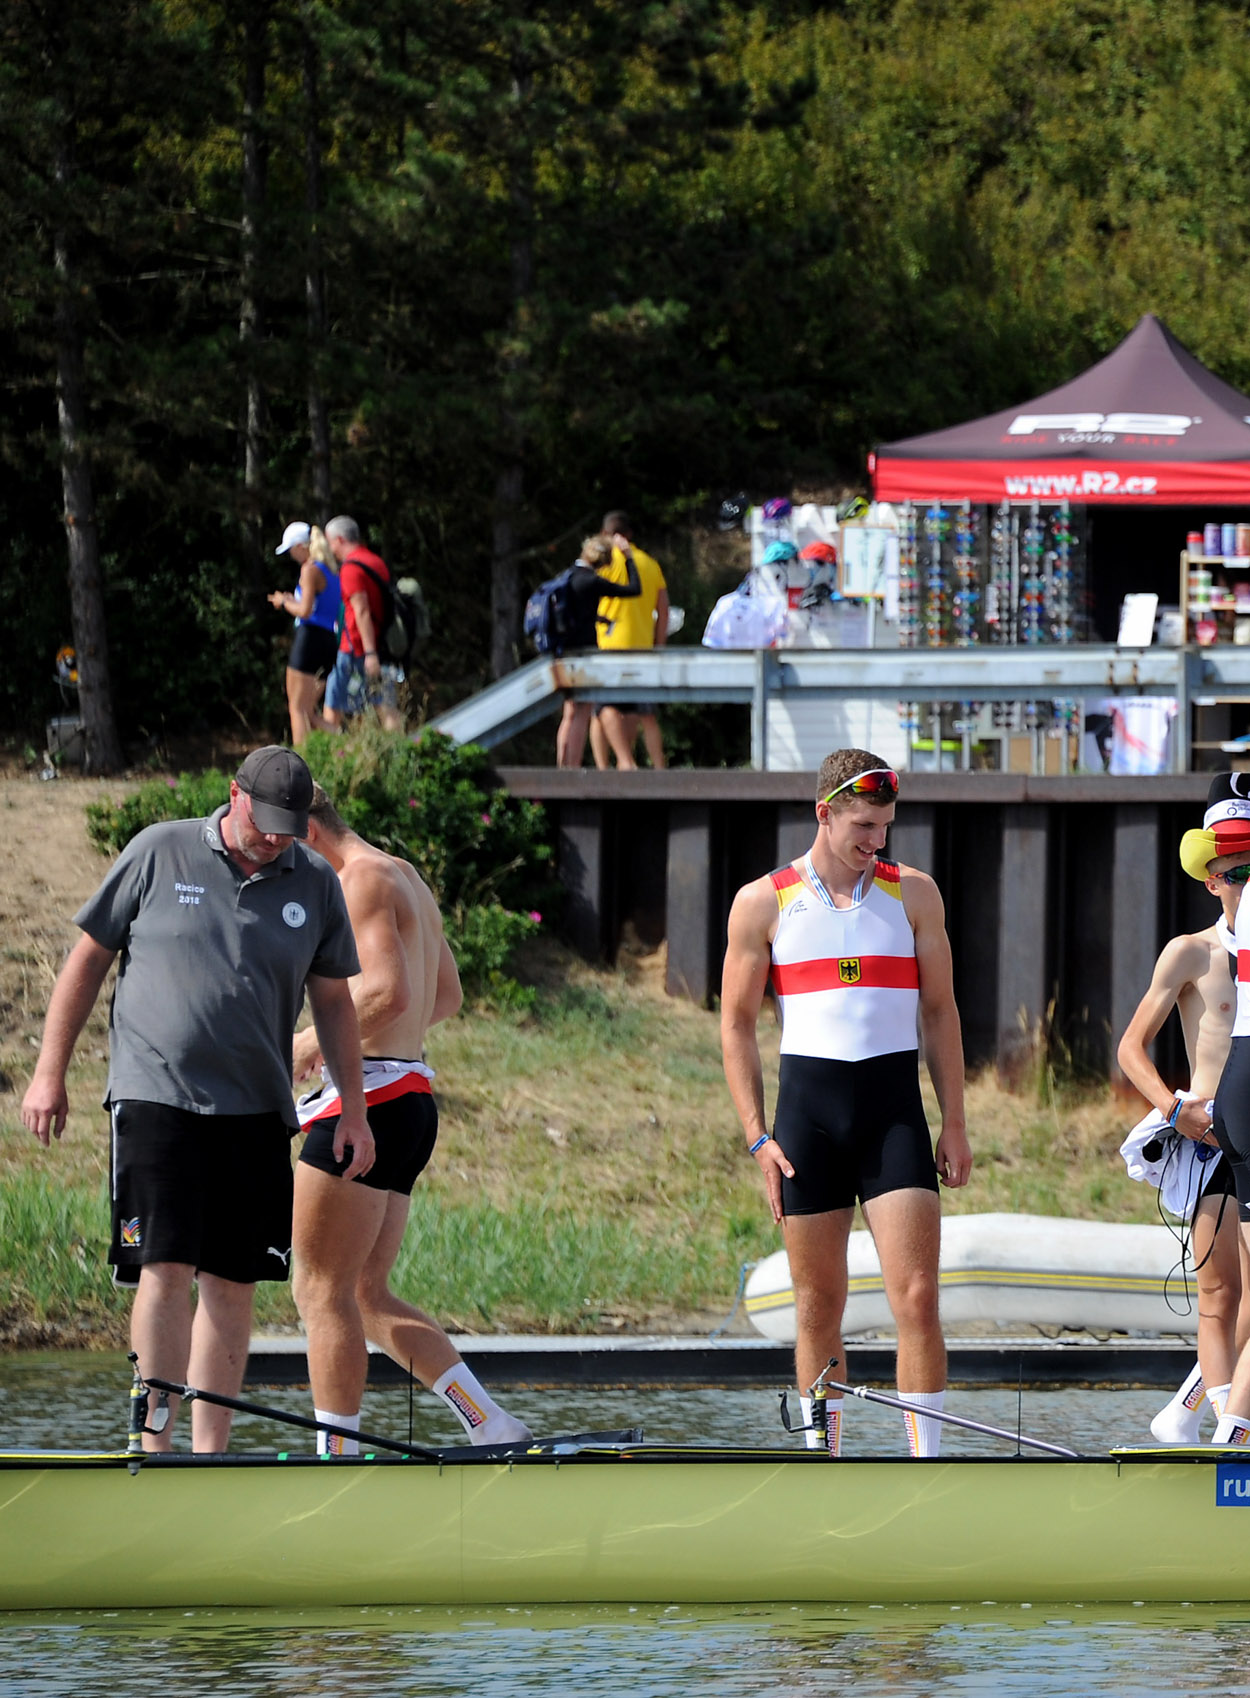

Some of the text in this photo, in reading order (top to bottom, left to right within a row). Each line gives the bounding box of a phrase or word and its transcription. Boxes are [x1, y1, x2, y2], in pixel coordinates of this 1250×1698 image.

[1057, 432, 1116, 444] YOUR
[1005, 471, 1157, 495] www.R2.cz
[178, 895, 200, 905] 2018
[446, 1386, 483, 1426] GERMANY
